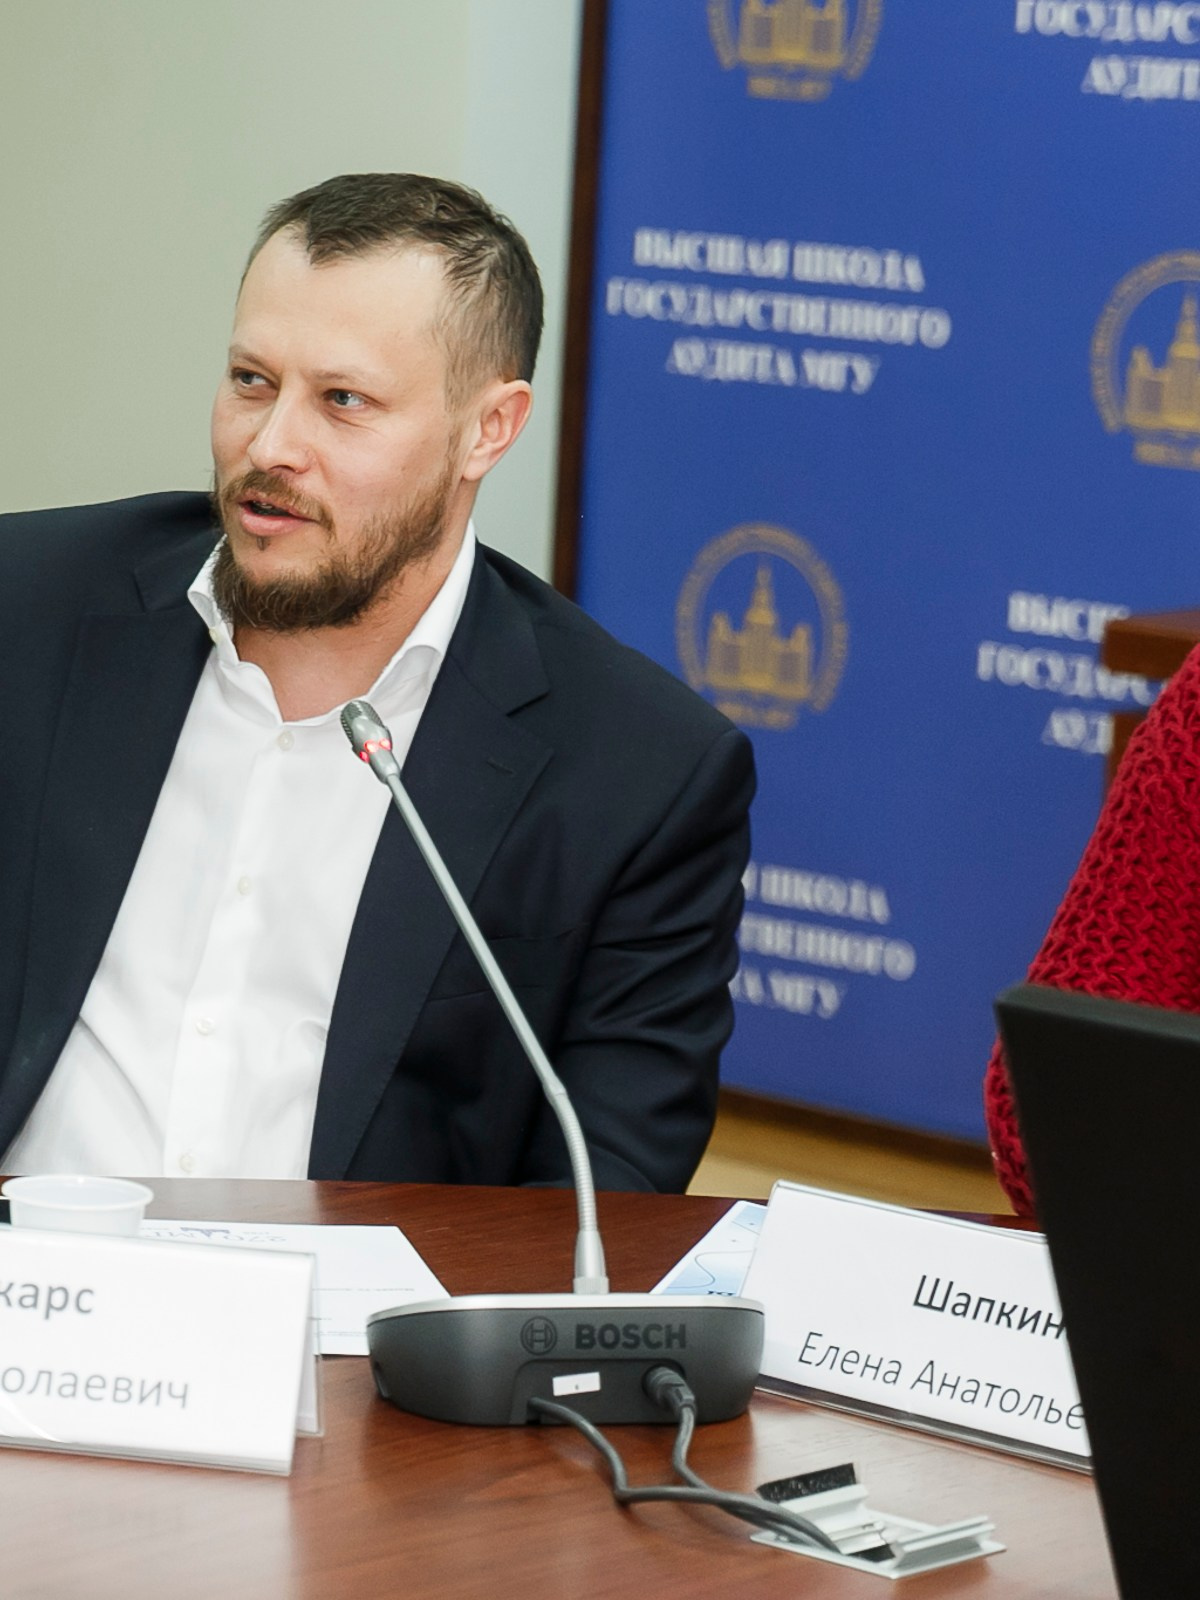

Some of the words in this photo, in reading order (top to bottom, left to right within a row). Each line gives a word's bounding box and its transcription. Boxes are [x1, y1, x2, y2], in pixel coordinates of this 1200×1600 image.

[633, 226, 789, 280] ВЫСШАЯ
[792, 240, 926, 293] ШКОЛА
[605, 275, 952, 349] ГОСУДАРСТВЕННОГО
[665, 336, 797, 387] АУДИТА
[800, 347, 880, 395] МГУ
[760, 864, 892, 925] ШКОЛА
[765, 969, 846, 1020] МГУ
[575, 1323, 687, 1350] BOSCH
[798, 1331, 902, 1386] Елена
